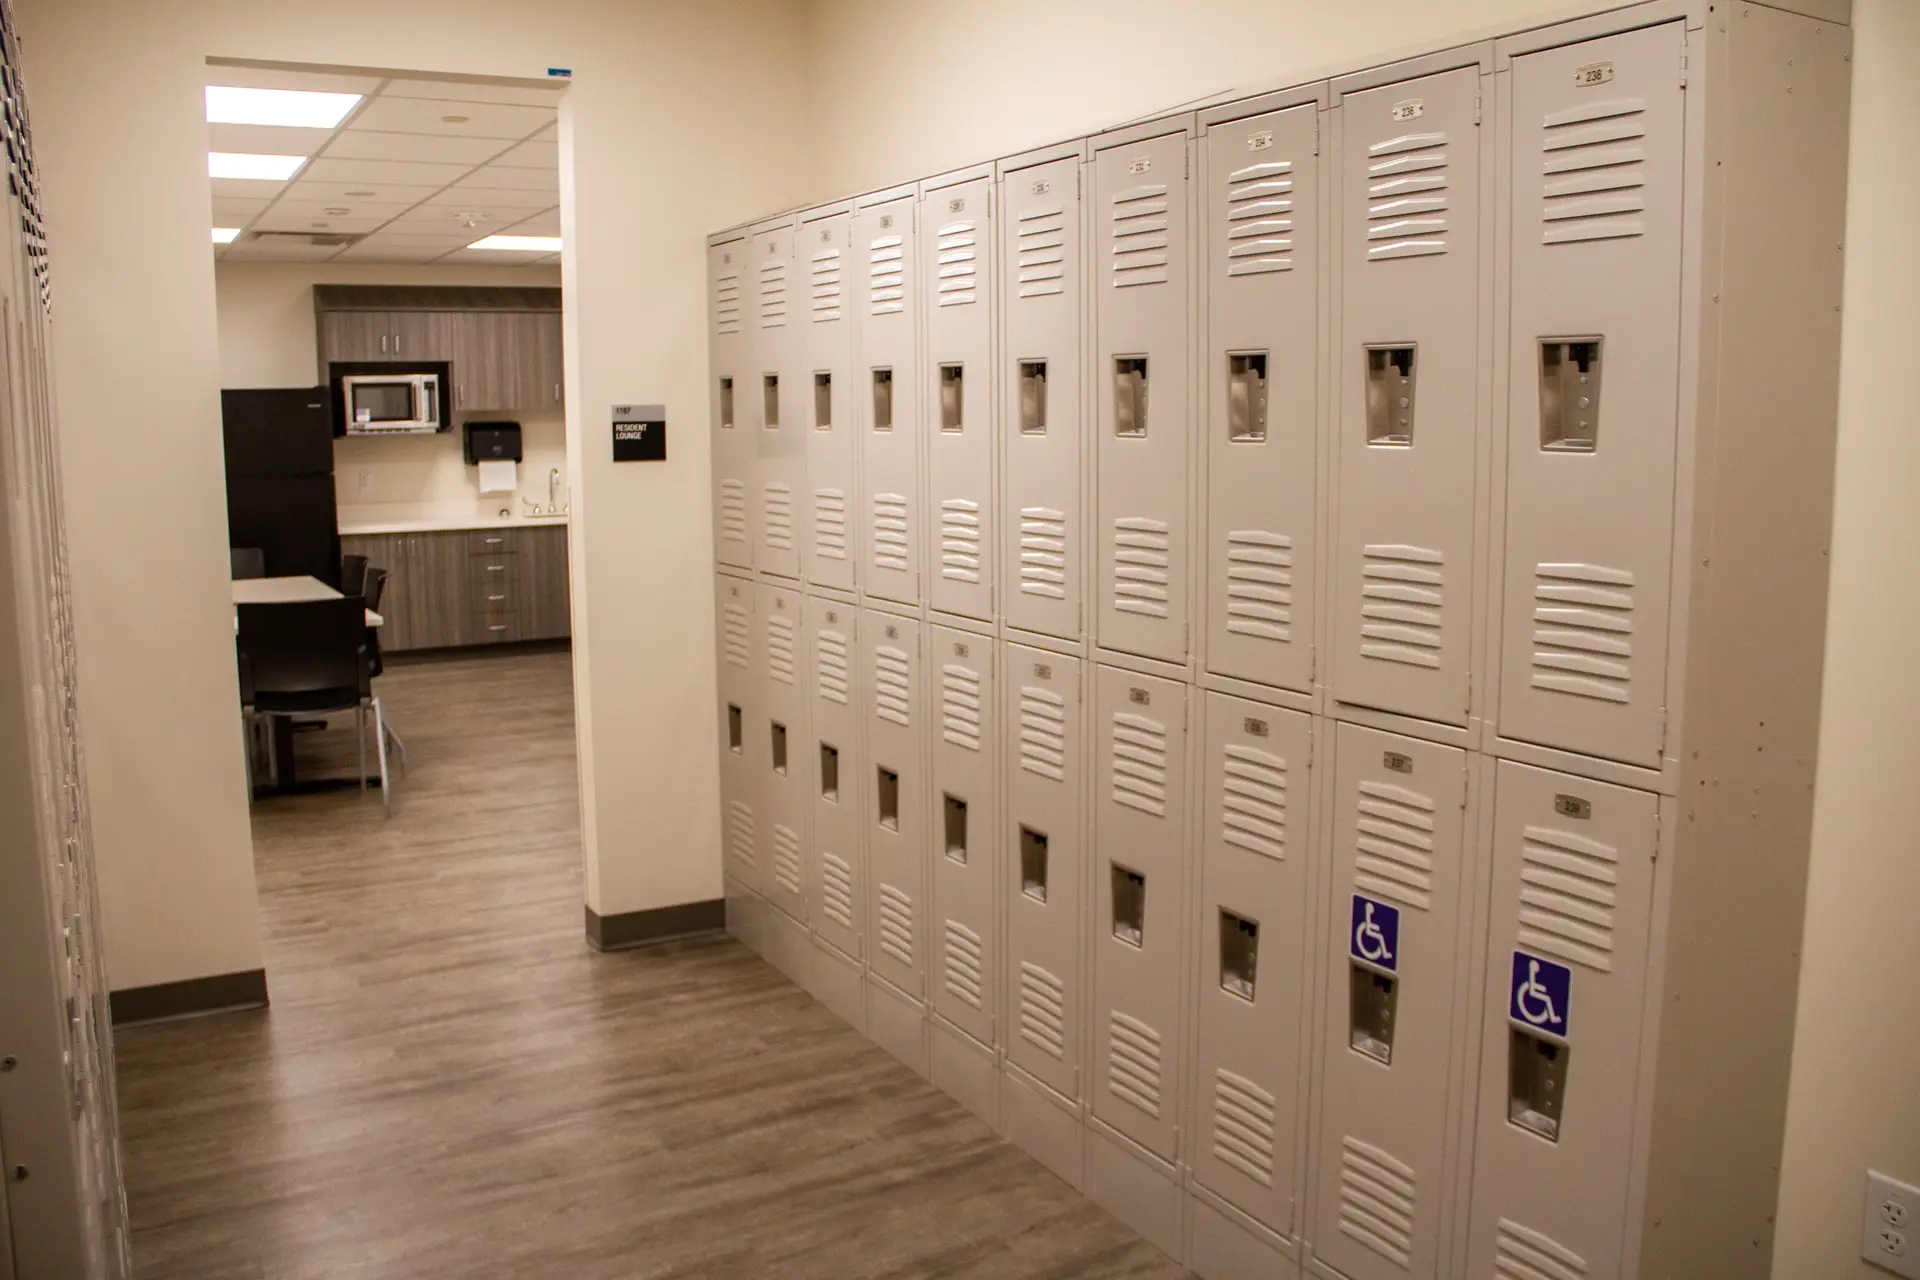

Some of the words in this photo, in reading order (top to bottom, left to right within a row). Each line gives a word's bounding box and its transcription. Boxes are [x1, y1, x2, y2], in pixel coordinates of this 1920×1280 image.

[1586, 69, 1602, 82] 238
[615, 423, 647, 432] RESIDENT
[616, 432, 642, 440] LOUNGE
